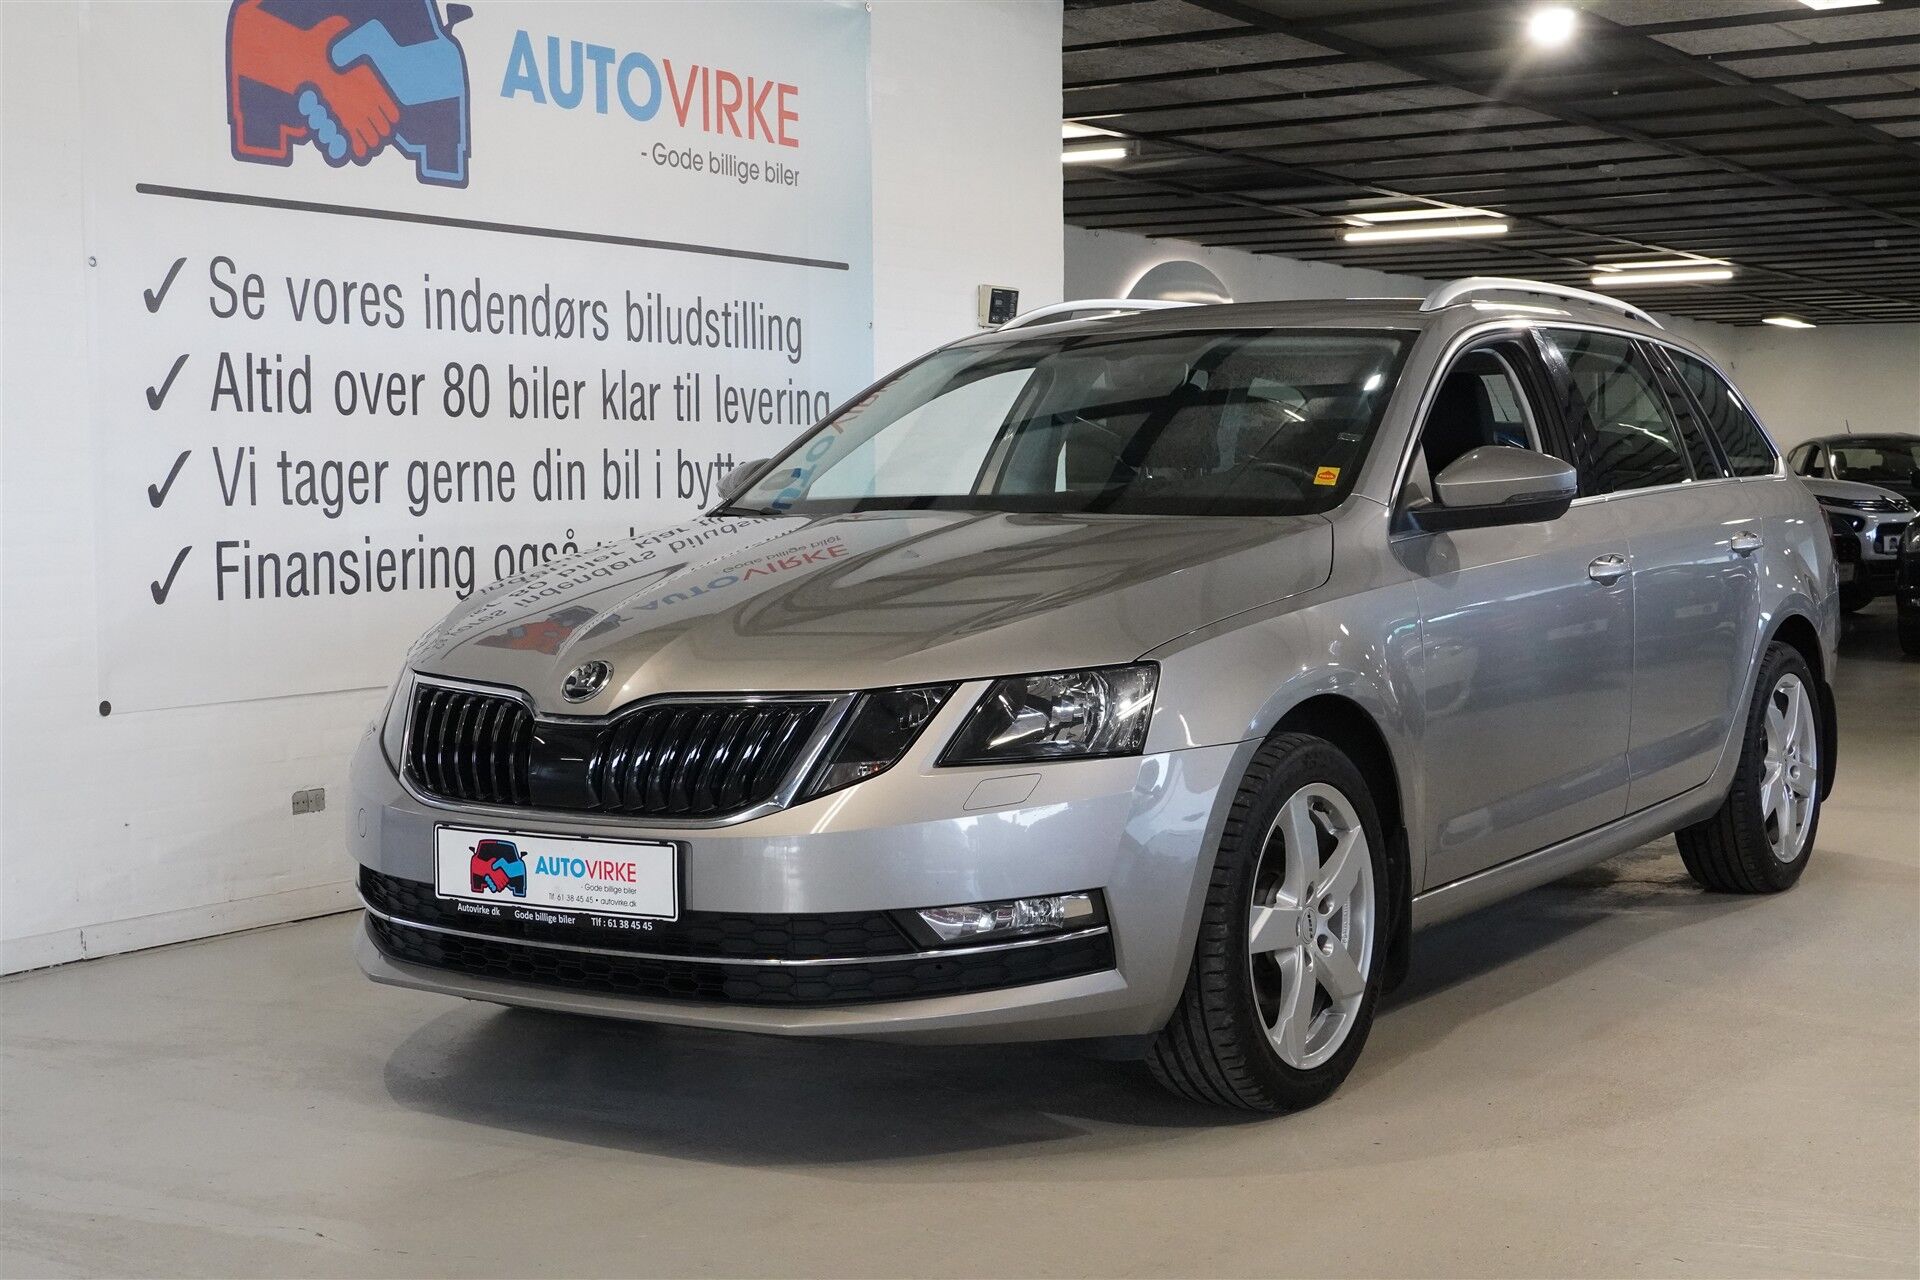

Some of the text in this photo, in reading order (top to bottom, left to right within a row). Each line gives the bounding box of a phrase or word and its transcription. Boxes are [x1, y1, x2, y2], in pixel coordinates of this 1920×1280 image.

[500, 29, 799, 148] AUTOVIRKE
[652, 142, 703, 171] Gode
[709, 151, 759, 184] billige
[764, 161, 800, 187] biler
[210, 255, 802, 364] Se vores indendørs biludstilling
[211, 352, 311, 416] Altid
[335, 370, 426, 418] over
[443, 362, 490, 420] 80
[509, 364, 587, 421] biler
[602, 369, 661, 423] klar
[673, 373, 700, 423] til
[212, 447, 256, 507] Vi
[277, 451, 389, 519] tager
[407, 460, 515, 517] gerne
[533, 448, 586, 503] din
[603, 448, 639, 501] bil
[656, 449, 662, 500] i
[216, 532, 475, 603] Finansiering
[535, 855, 637, 883] AUTOVIRKE
[514, 910, 576, 924] Gode billige biler
[607, 919, 618, 928] 61
[619, 920, 629, 929] 38
[630, 921, 641, 930] 45
[642, 922, 653, 931] 45
